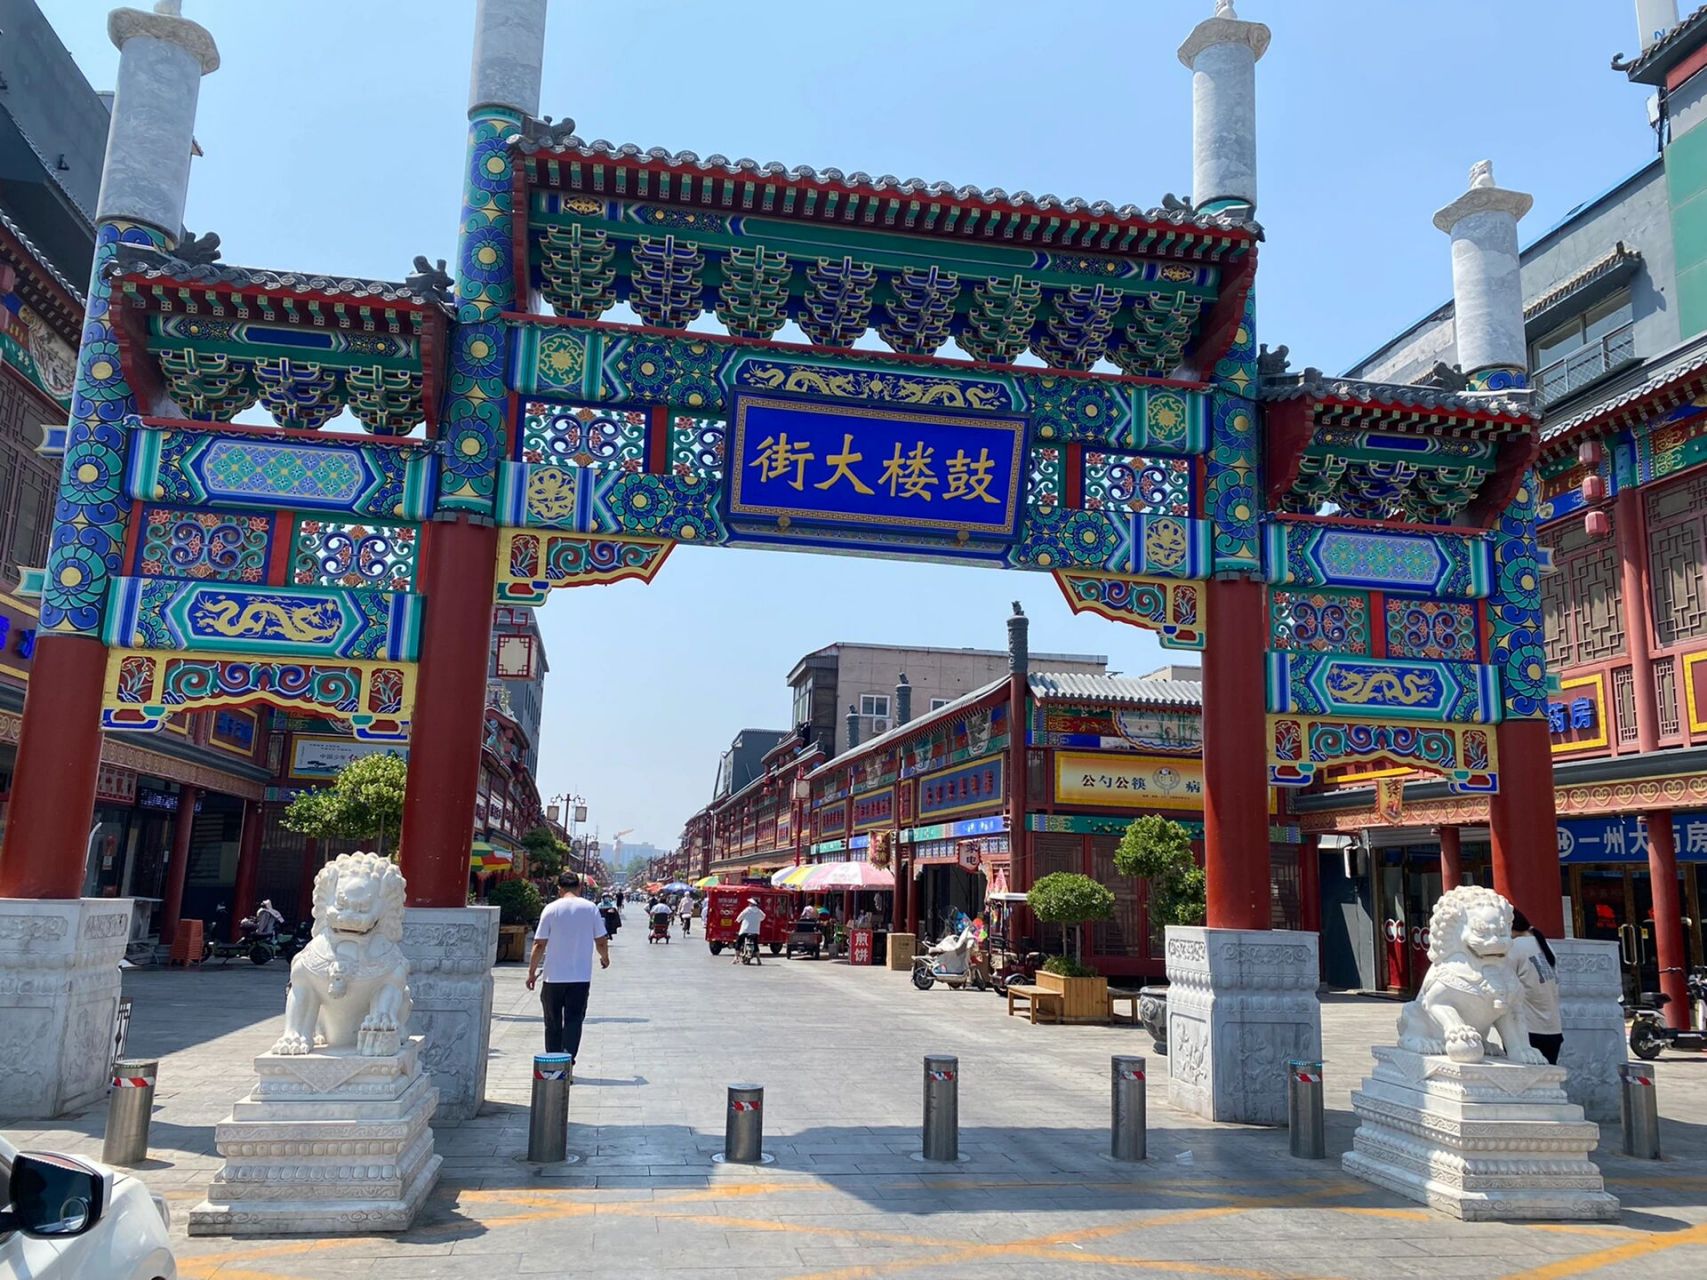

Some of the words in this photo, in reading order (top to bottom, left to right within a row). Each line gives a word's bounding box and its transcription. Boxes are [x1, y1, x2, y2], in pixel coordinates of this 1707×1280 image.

[1081, 773, 1146, 791] 公勺公筷
[854, 931, 869, 962] 煎饼
